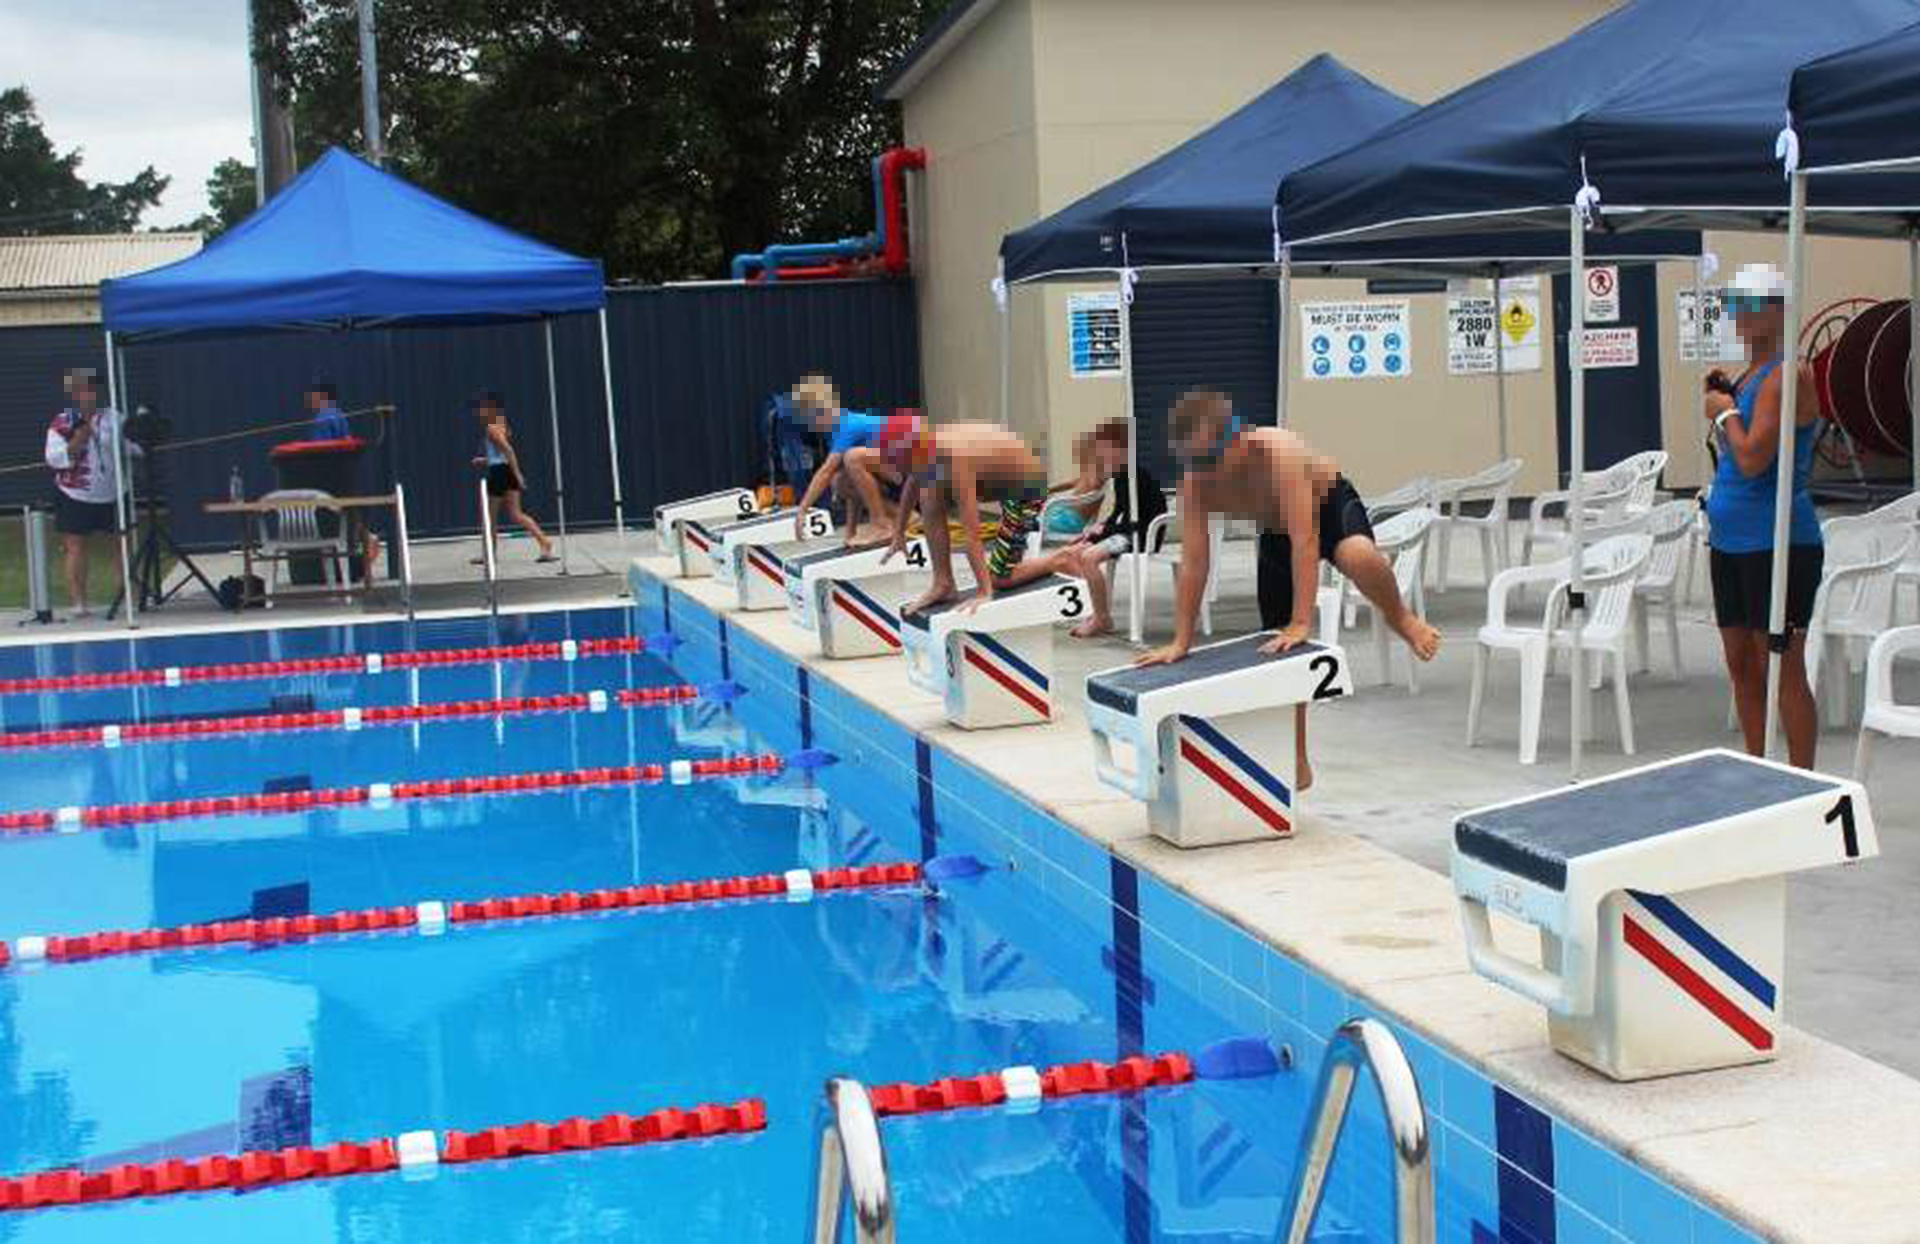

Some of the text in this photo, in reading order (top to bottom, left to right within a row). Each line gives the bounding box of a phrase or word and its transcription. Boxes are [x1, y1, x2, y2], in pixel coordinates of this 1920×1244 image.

[1311, 311, 1400, 325] MUST BE WORN
[1688, 307, 1720, 321] 189
[1457, 317, 1493, 333] 2880
[1583, 331, 1631, 341] AZCHEM
[738, 494, 753, 513] 6
[810, 514, 827, 536] 5
[906, 542, 927, 568] 4
[1058, 585, 1083, 617] 3
[1309, 654, 1343, 700] 2
[1825, 794, 1859, 858] 1
